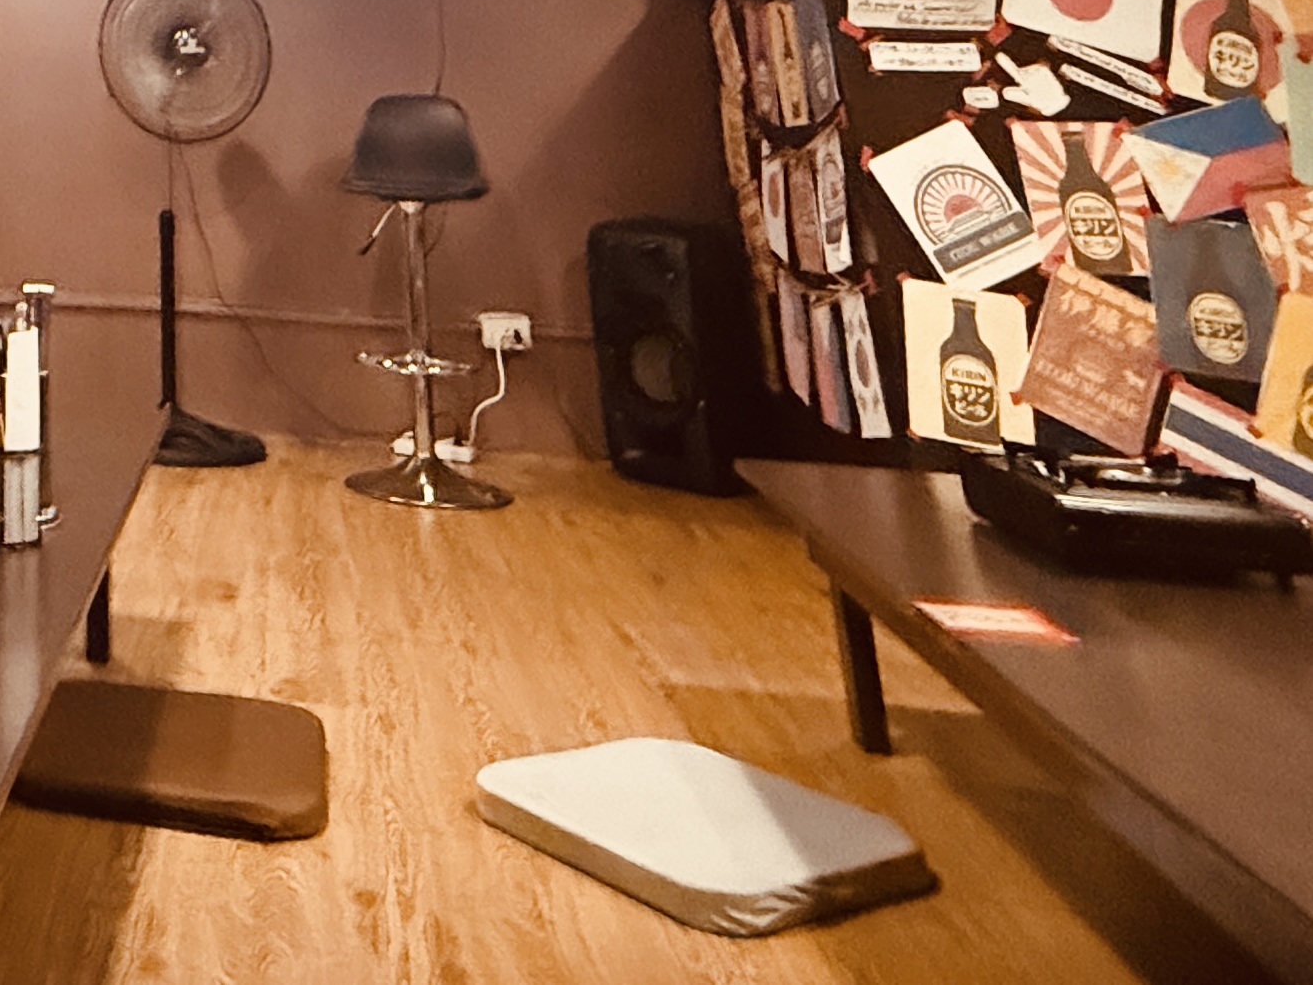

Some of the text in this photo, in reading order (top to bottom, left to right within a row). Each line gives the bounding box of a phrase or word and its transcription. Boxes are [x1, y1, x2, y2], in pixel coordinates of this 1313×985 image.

[951, 367, 987, 382] KIRIN
[949, 383, 991, 404] キリン
